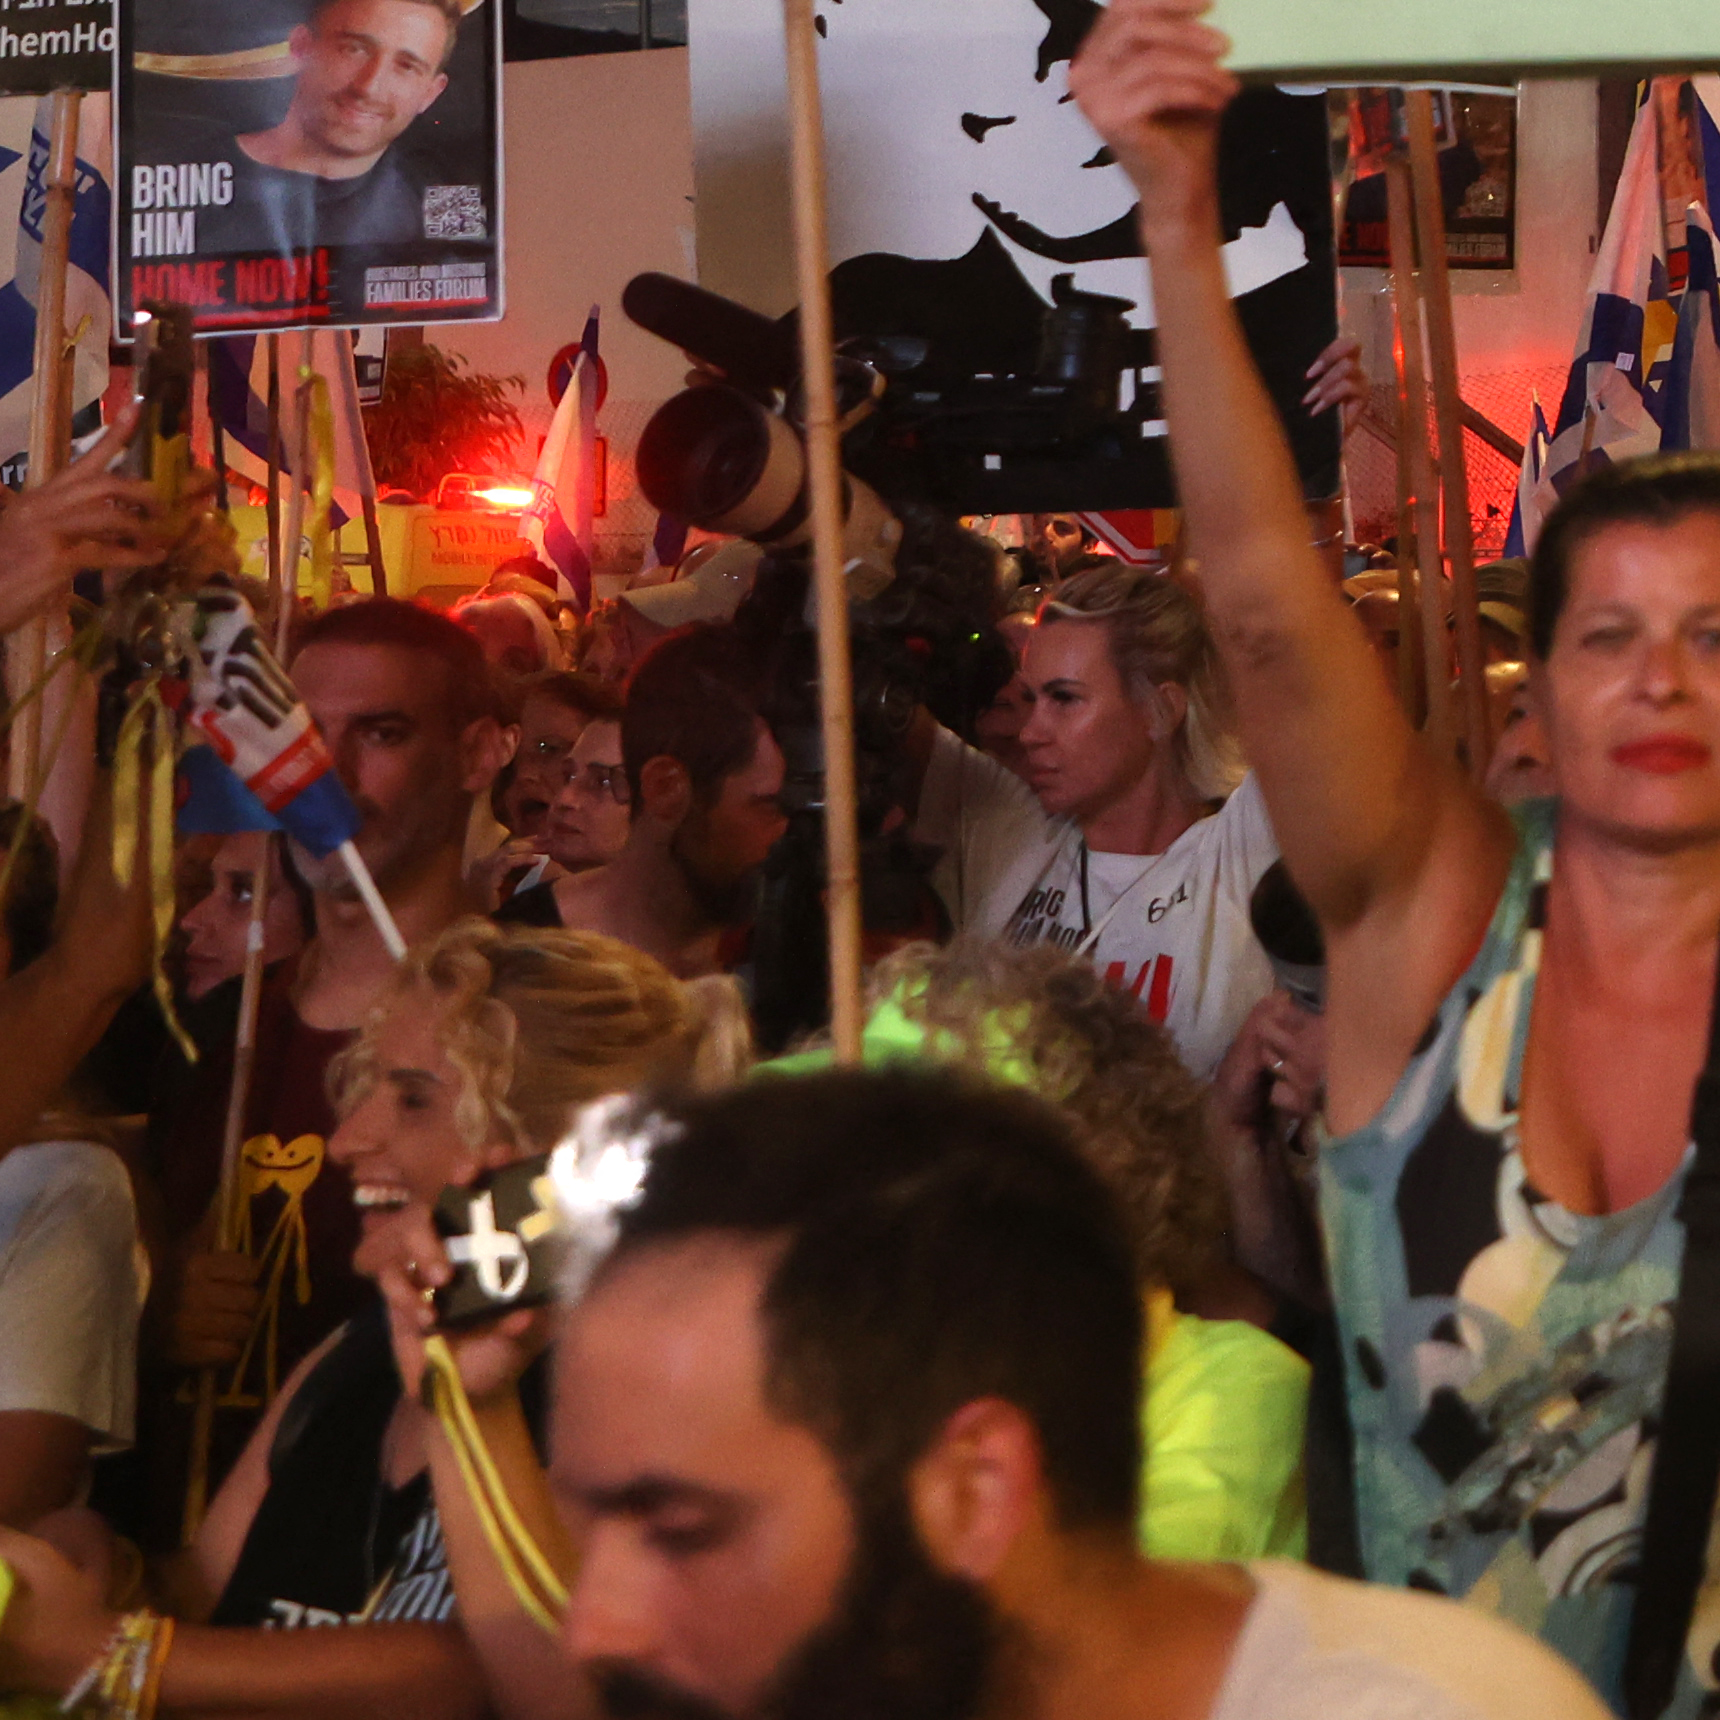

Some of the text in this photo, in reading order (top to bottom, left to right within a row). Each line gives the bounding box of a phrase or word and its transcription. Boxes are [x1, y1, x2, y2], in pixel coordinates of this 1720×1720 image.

[132, 162, 234, 210] BRING
[131, 211, 196, 257] HIM
[131, 247, 331, 310] HOME NOW!
